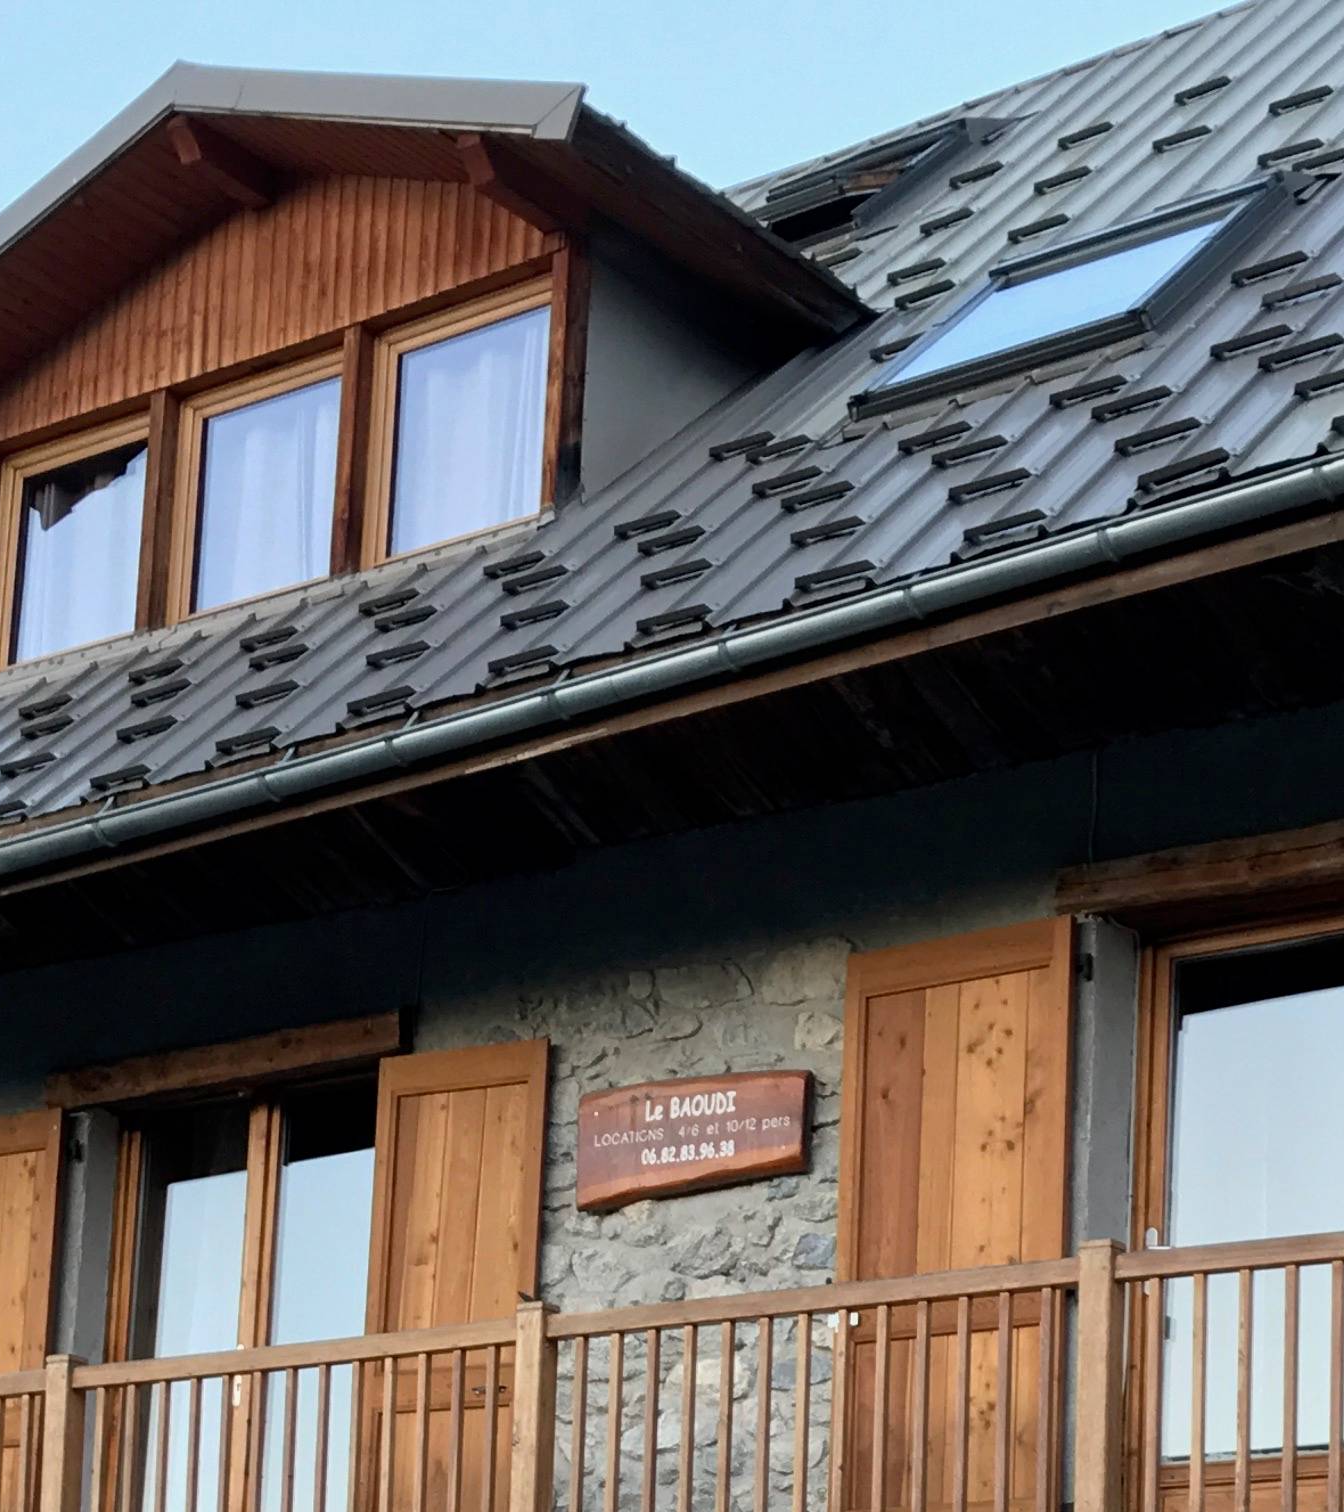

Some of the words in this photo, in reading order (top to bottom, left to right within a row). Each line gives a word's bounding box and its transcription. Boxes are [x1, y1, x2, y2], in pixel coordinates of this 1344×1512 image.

[645, 1100, 663, 1122] Le
[670, 1091, 736, 1120] BAOUDI
[594, 1127, 664, 1148] LOCATIONS
[678, 1124, 699, 1138] 4/6
[707, 1122, 720, 1135] et
[726, 1117, 757, 1133] 10/12
[762, 1115, 791, 1131] pers
